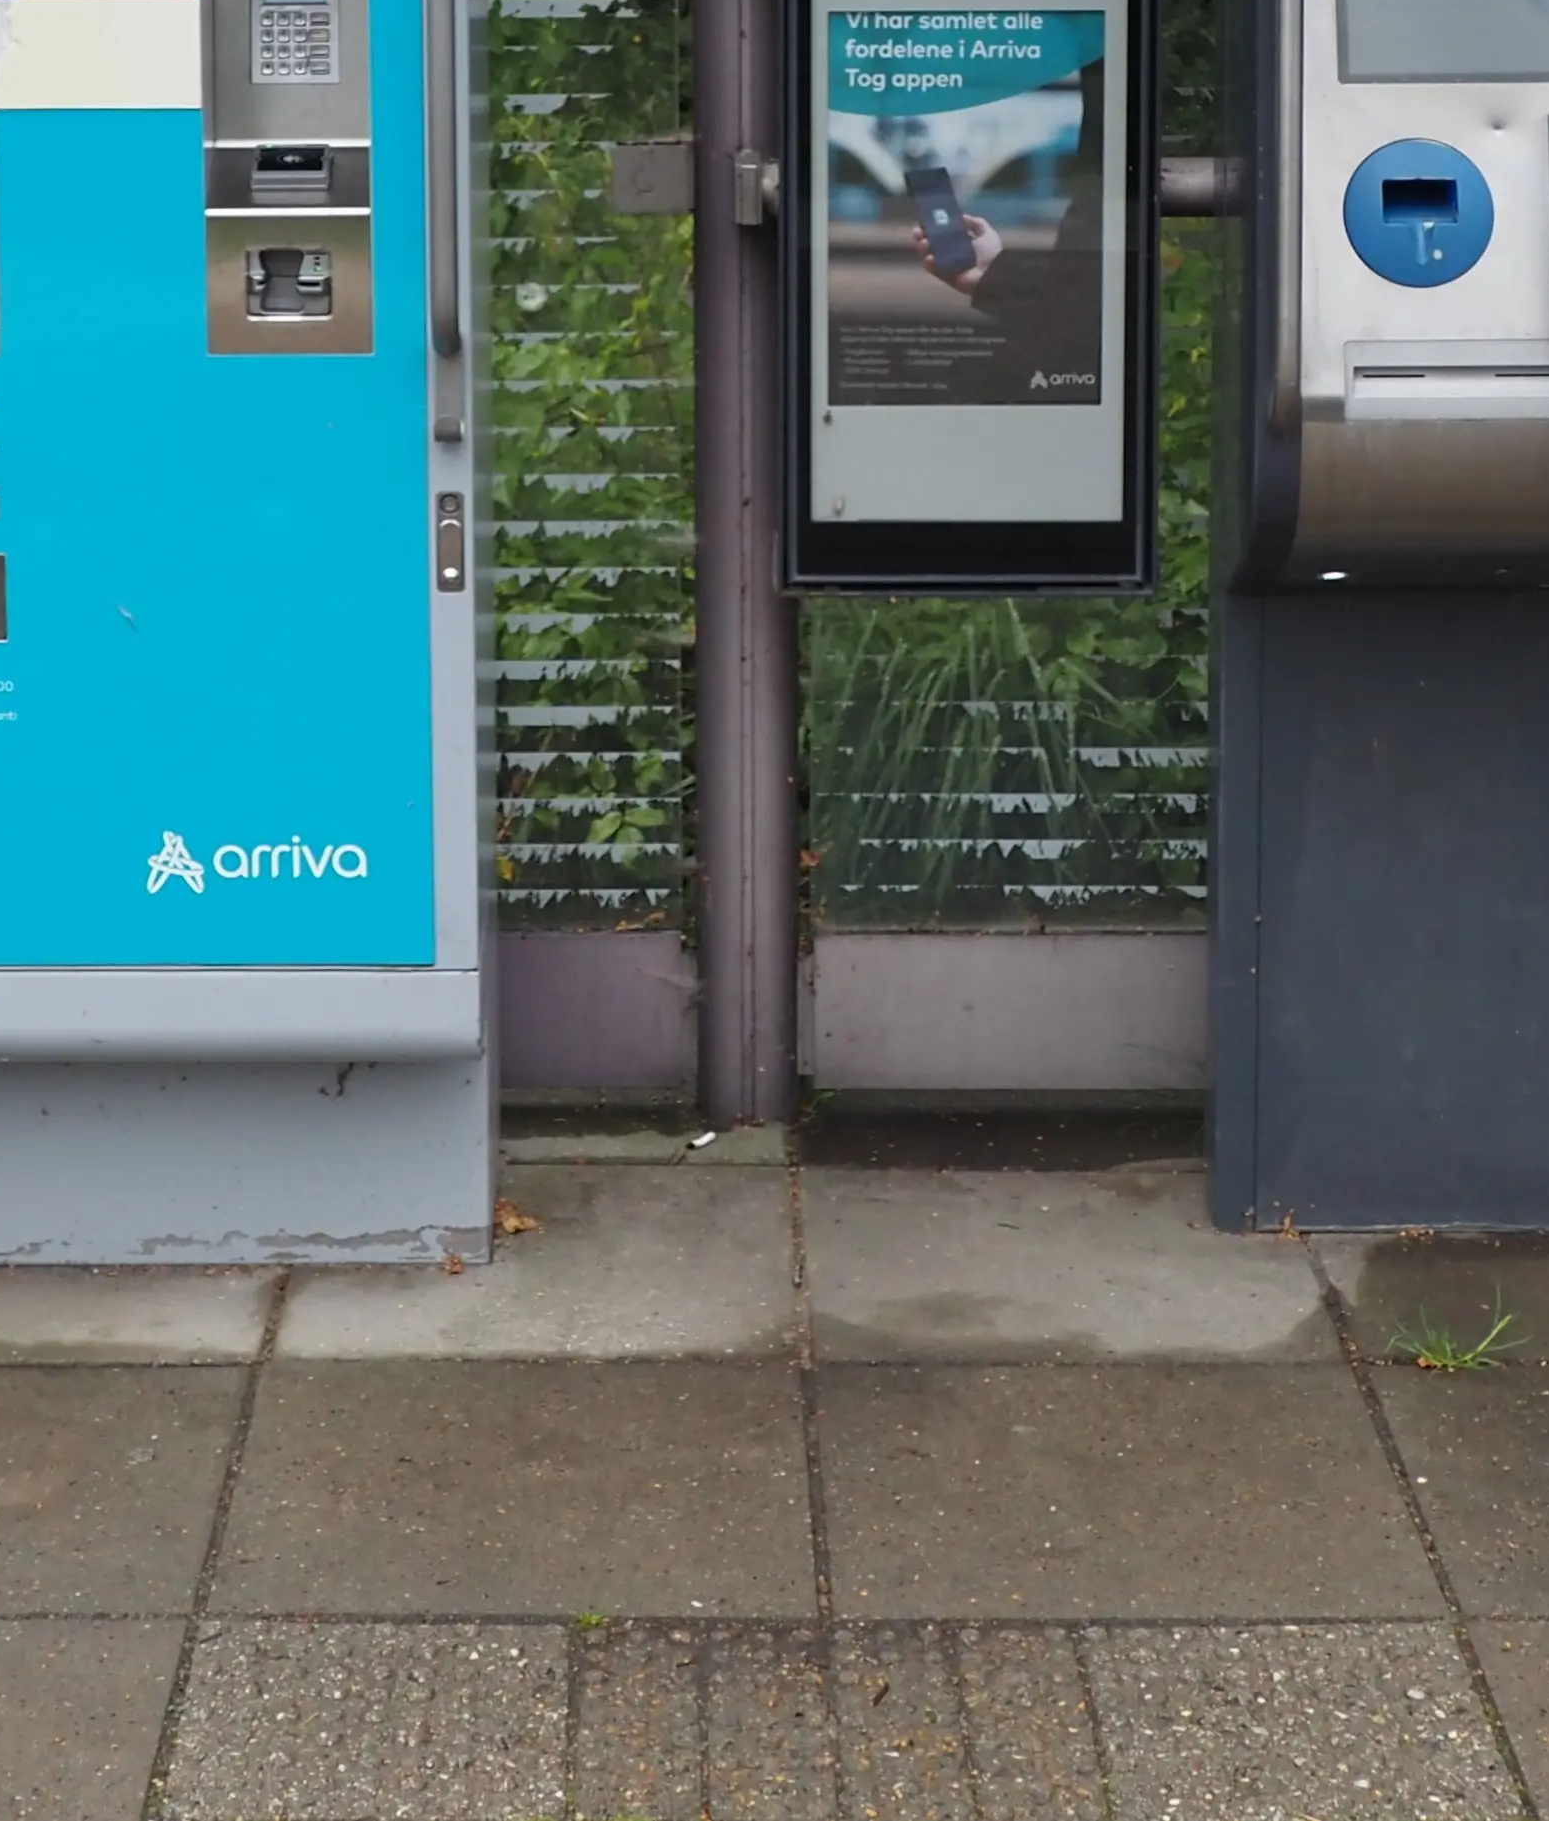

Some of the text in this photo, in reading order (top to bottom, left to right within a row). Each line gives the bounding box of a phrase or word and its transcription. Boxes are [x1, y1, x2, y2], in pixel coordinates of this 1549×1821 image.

[845, 13, 1044, 31] Vi har samlet alle
[844, 37, 1041, 59] fordelene i Arriva
[844, 67, 963, 92] Tog appen
[212, 834, 368, 878] arriva
